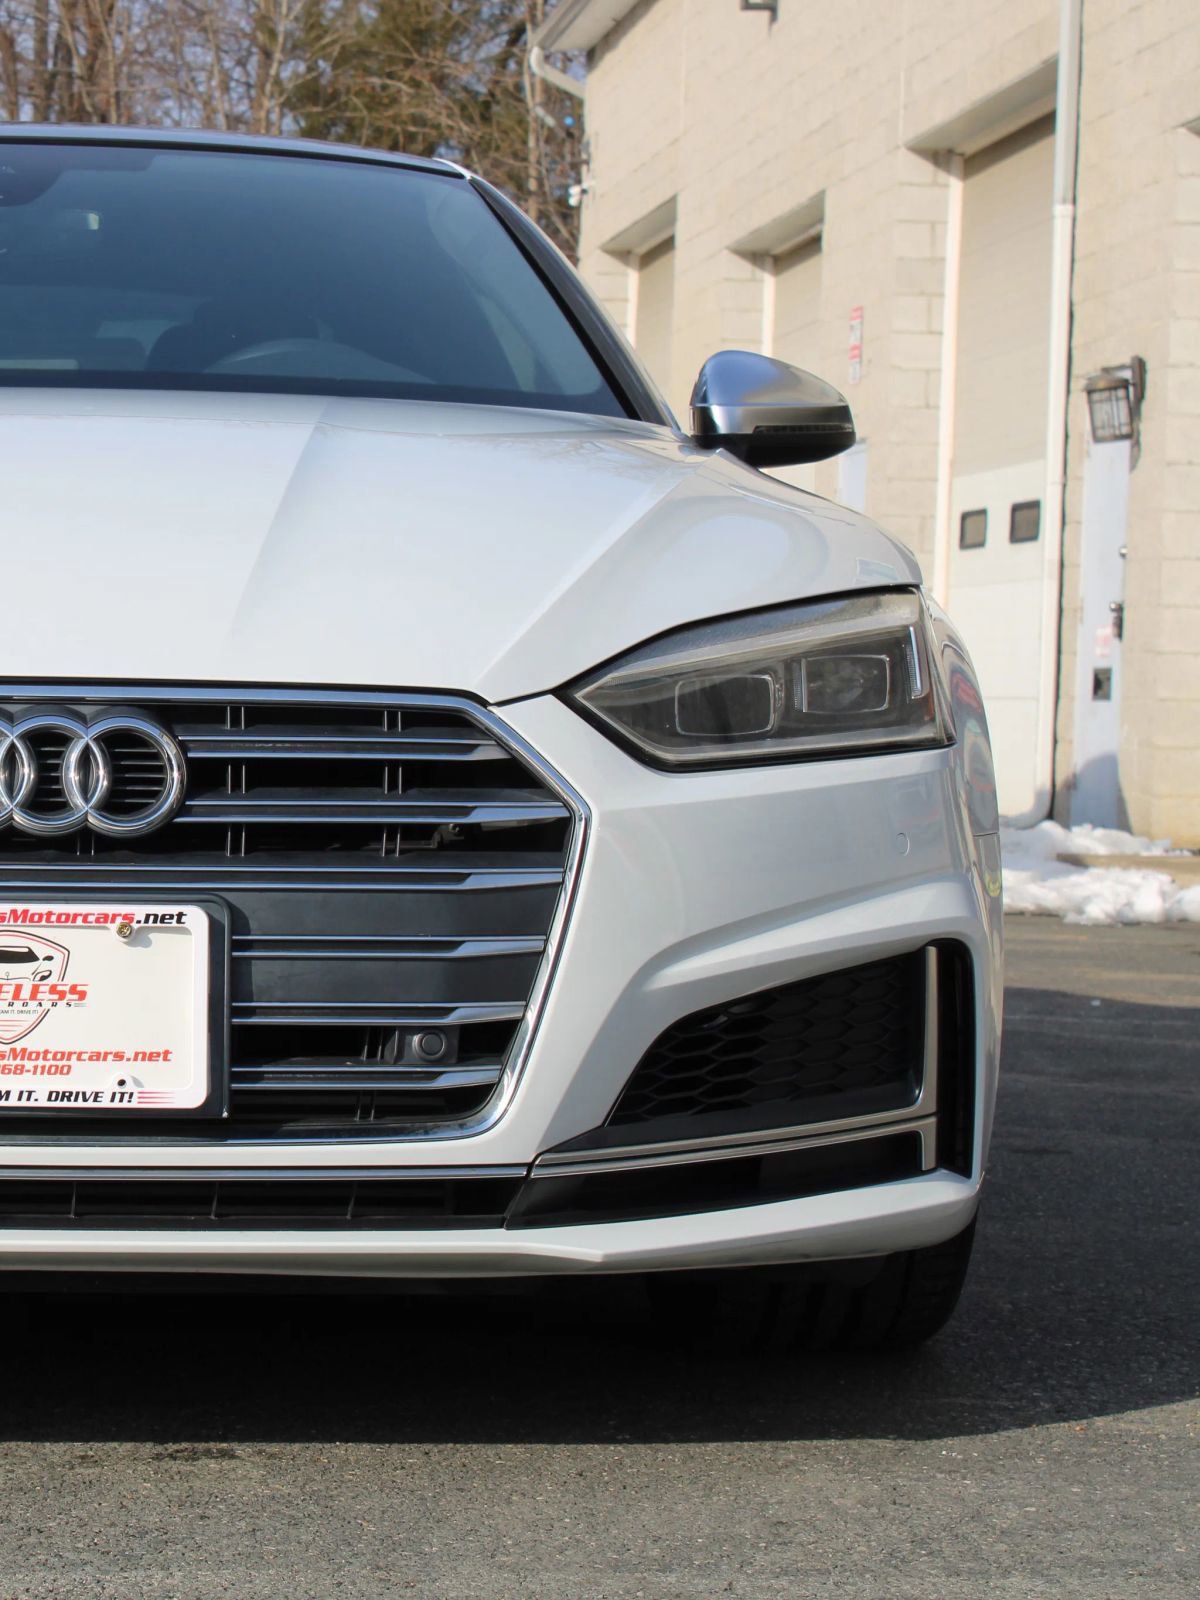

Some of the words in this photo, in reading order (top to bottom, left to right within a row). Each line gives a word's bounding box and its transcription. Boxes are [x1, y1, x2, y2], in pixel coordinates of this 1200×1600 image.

[16, 1090, 39, 1102] IT.
[46, 1090, 105, 1103] DRIVE
[109, 1091, 135, 1104] IT!
